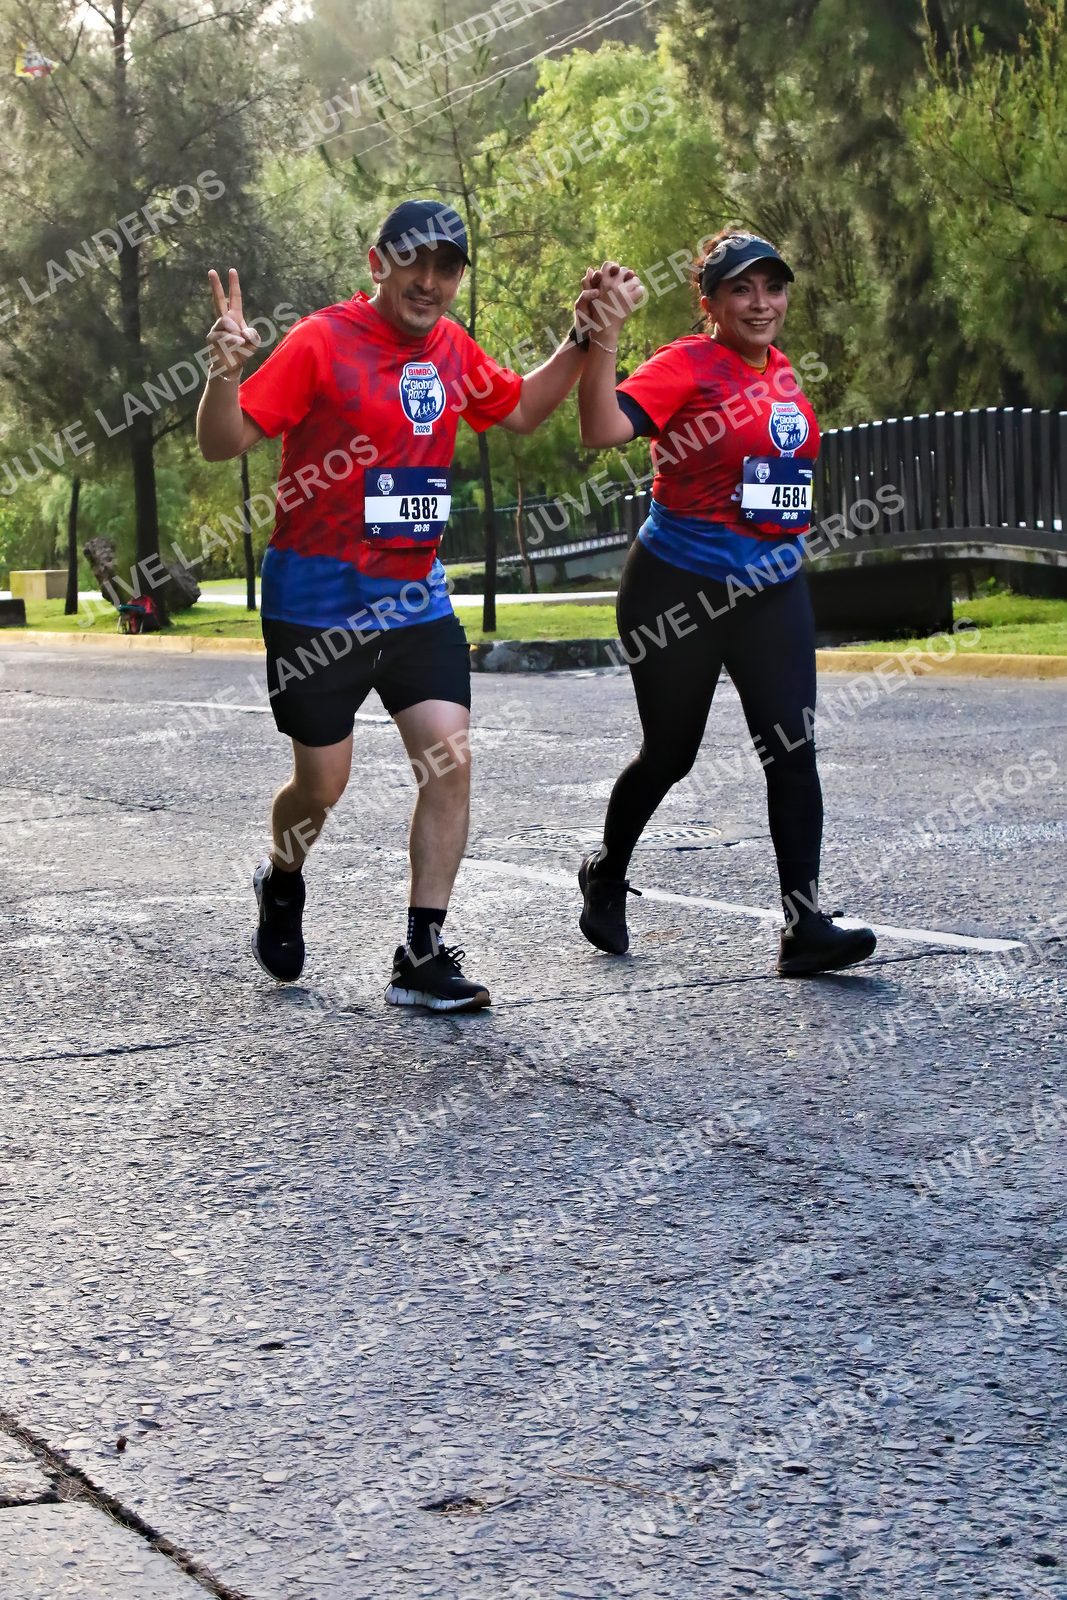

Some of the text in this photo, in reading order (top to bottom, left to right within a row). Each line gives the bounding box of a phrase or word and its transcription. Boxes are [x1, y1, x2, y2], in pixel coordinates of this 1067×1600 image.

[408, 390, 427, 400] Race
[414, 425, 431, 433] 2026
[771, 487, 807, 508] 4584
[399, 497, 438, 520] 4382
